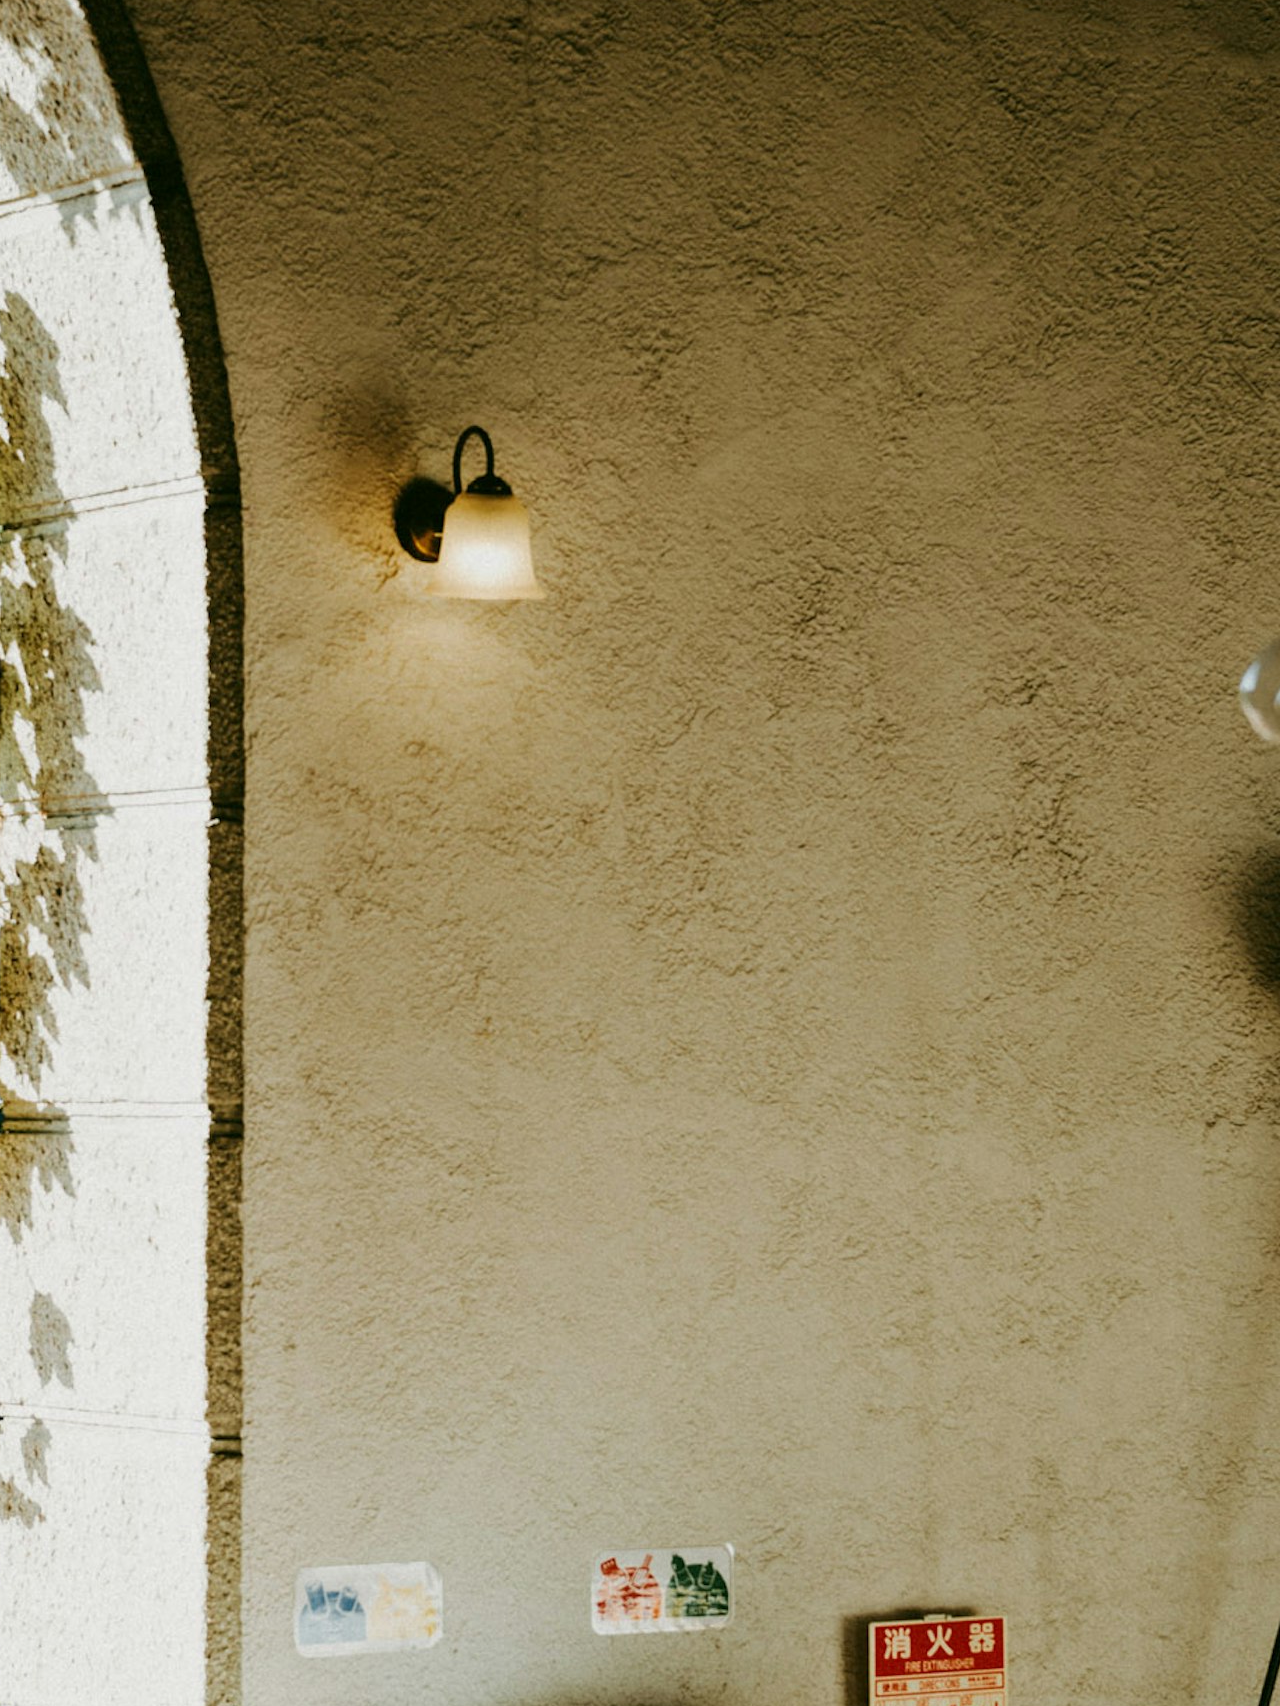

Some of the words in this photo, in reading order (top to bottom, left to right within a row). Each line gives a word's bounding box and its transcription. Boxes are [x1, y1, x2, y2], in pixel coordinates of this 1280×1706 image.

[883, 1621, 996, 1660] 消火器
[904, 1660, 921, 1673] FIRE
[922, 1657, 975, 1672] EXTINGUISHER
